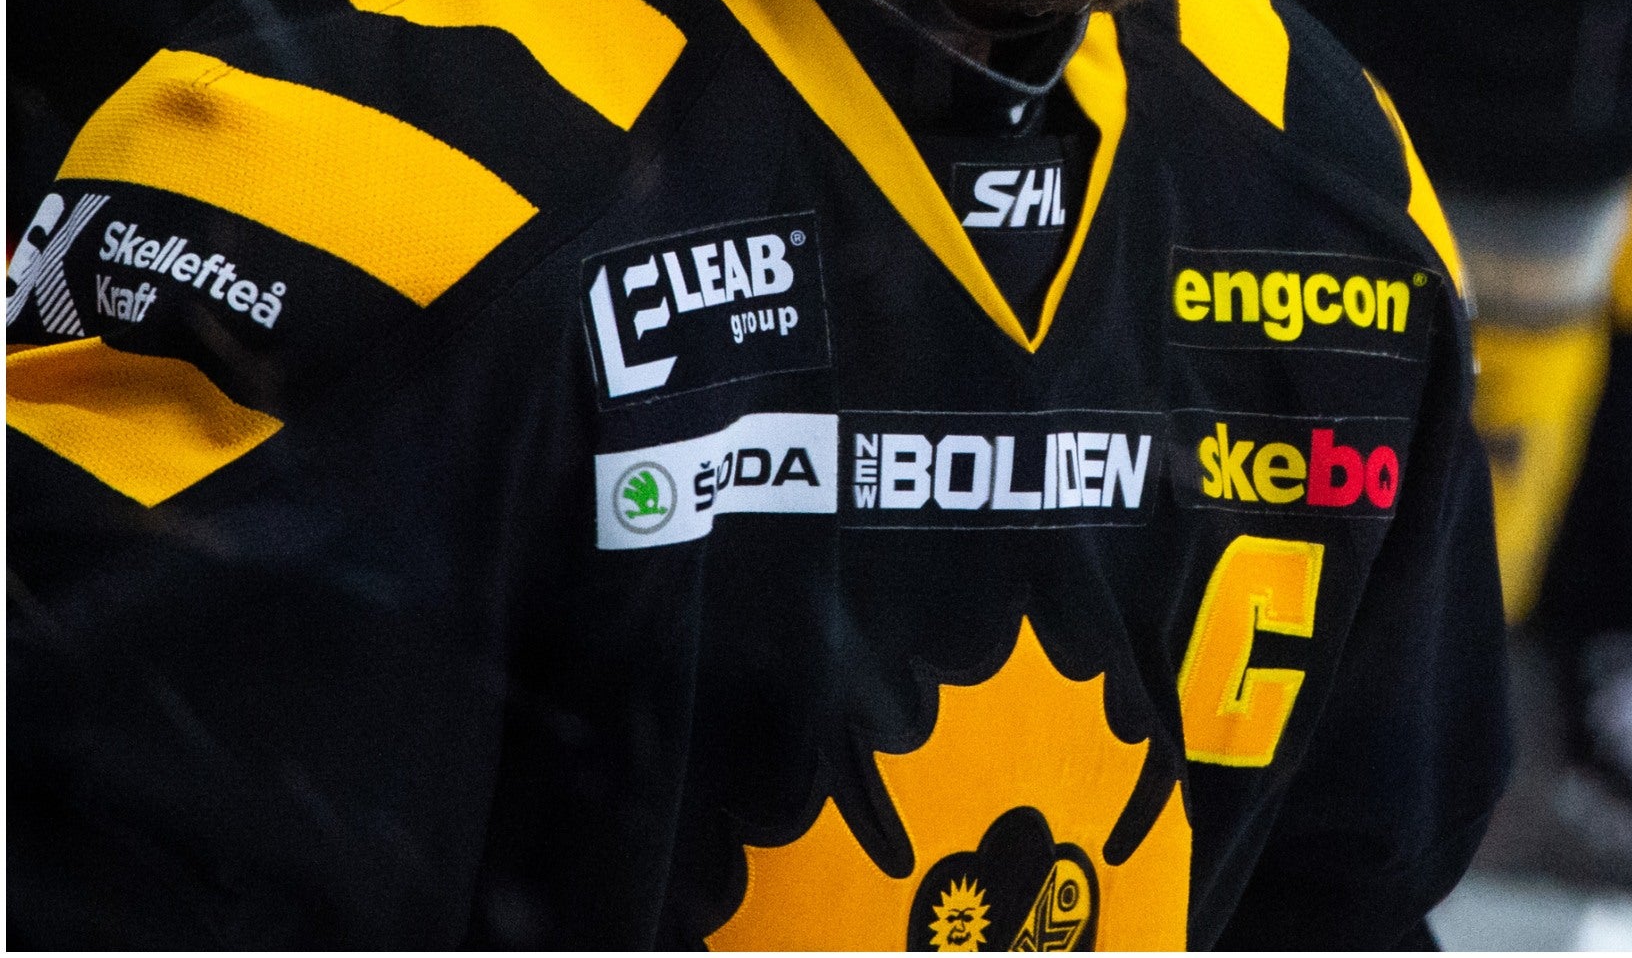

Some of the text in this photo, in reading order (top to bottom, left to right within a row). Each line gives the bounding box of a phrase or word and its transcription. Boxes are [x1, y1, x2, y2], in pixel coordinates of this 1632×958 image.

[962, 167, 1066, 228] SHL
[96, 274, 158, 323] Kraft
[99, 220, 286, 329] Skellefteå
[1175, 268, 1411, 342] engcon
[731, 305, 799, 344] group
[694, 447, 821, 512] ŠODA
[854, 432, 1152, 510] NEW BOLIDEN
[1198, 422, 1400, 509] skebo
[1177, 534, 1325, 768] C
